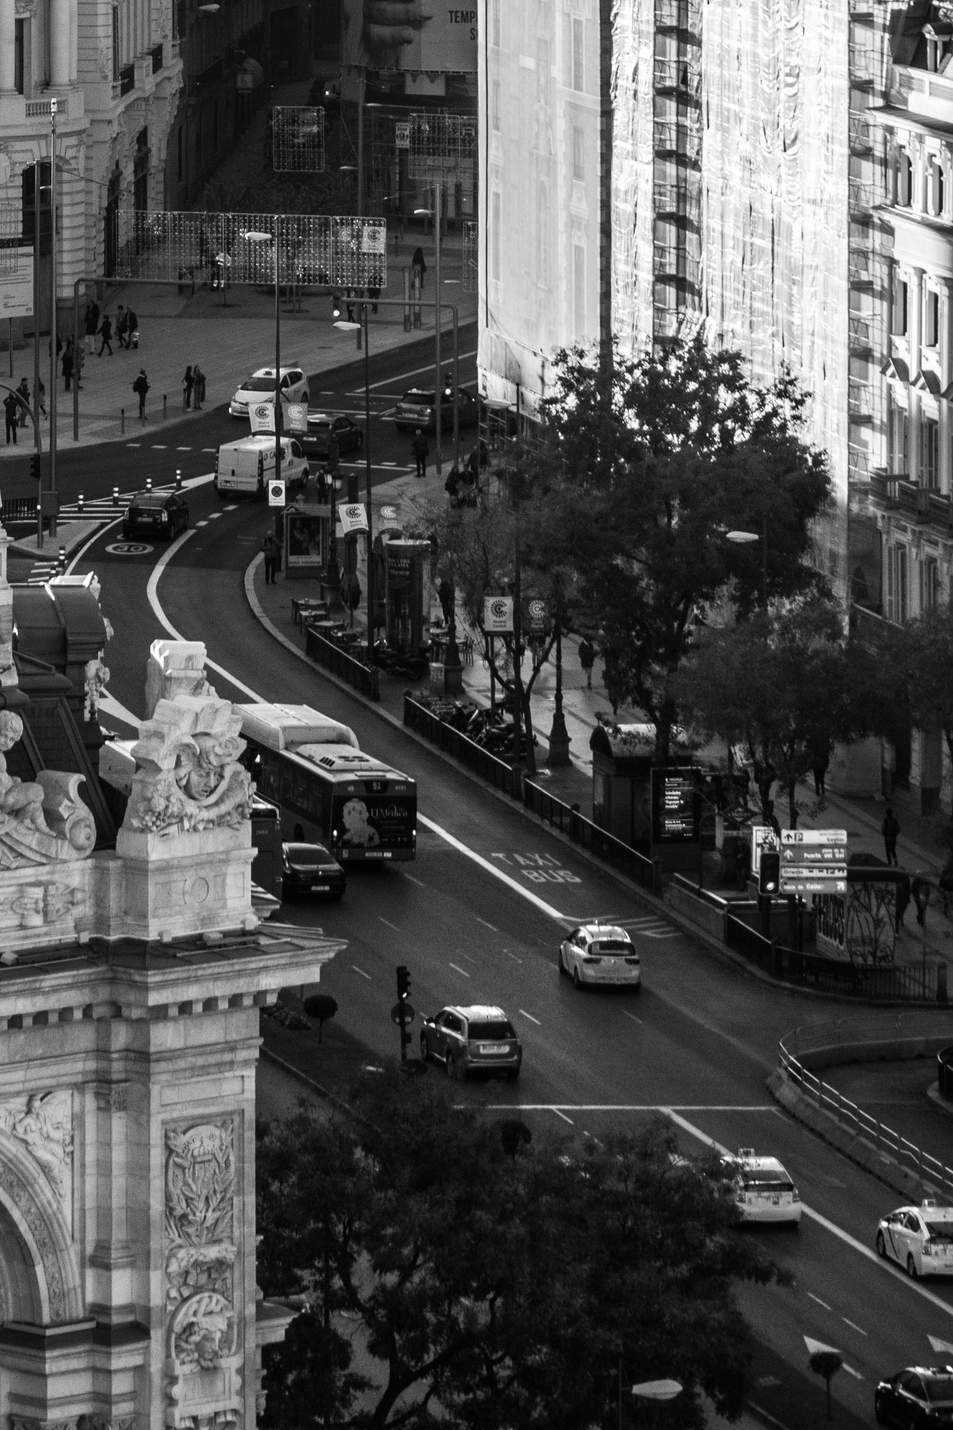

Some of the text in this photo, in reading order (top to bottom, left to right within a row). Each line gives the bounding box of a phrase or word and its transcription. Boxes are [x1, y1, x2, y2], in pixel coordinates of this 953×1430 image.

[448, 10, 478, 23] TEMP
[116, 544, 144, 552] 30
[372, 781, 381, 790] 51
[491, 853, 562, 866] TAXI
[520, 870, 582, 882] BUS
